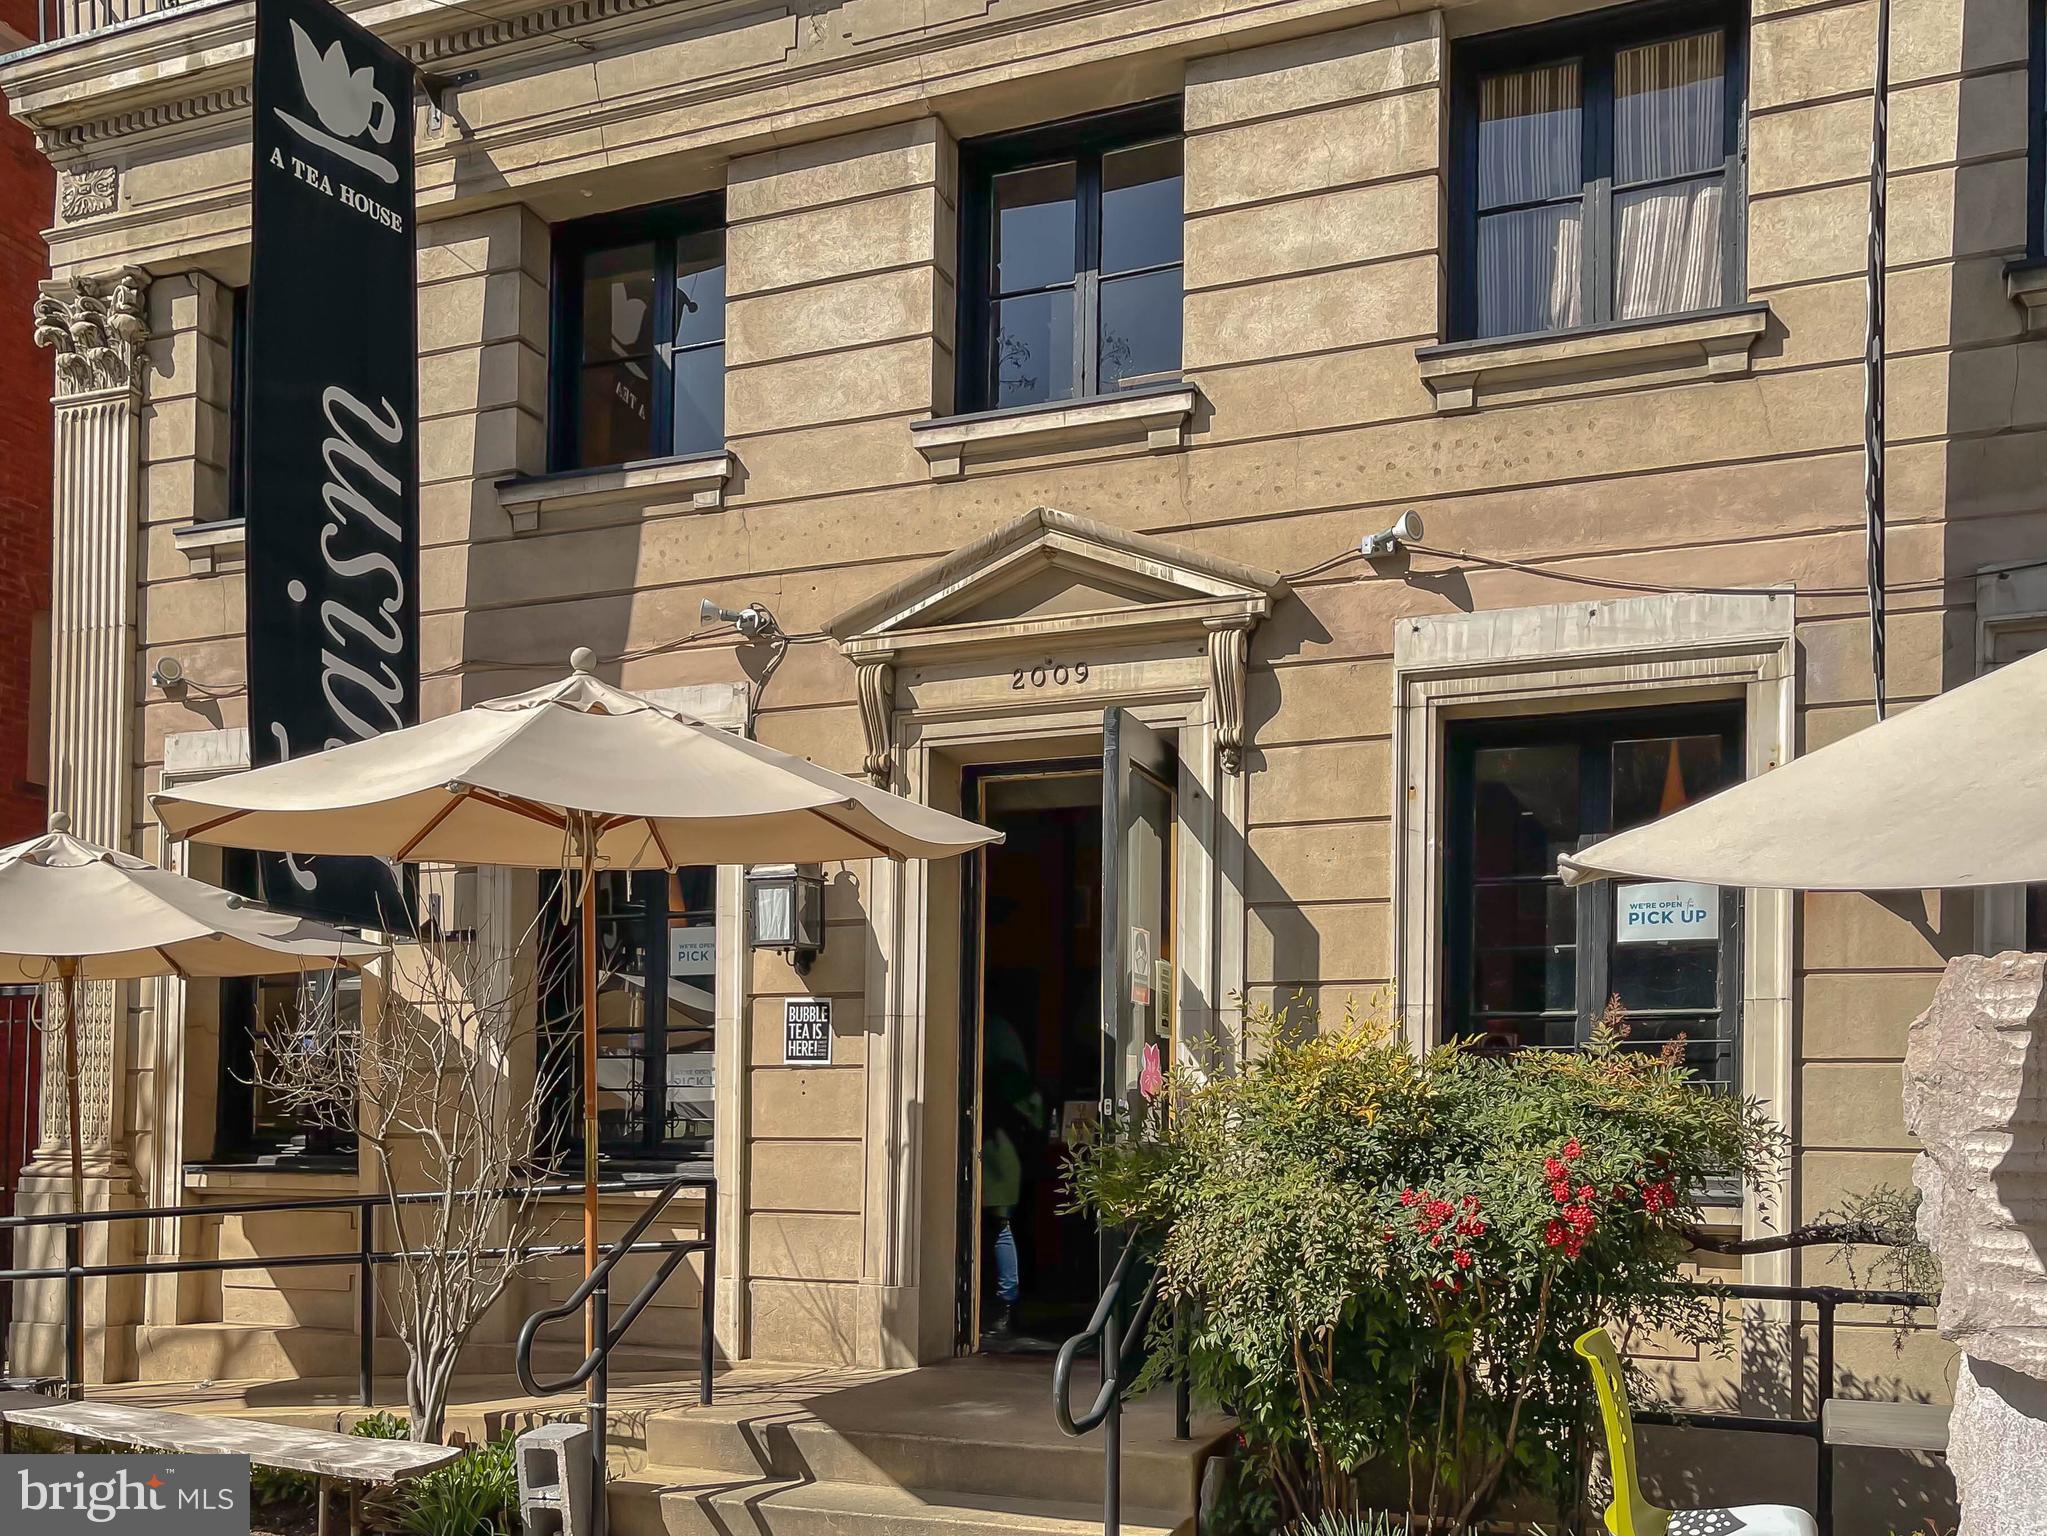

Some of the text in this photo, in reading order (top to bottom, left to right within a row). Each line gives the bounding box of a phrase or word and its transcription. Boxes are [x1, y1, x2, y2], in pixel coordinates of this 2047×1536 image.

[269, 147, 402, 233] A TEA HOUSE
[271, 386, 403, 890] aism
[1012, 662, 1089, 690] 2009
[1629, 902, 1657, 910] WE'RE
[1628, 910, 1707, 925] PICK UP
[678, 951, 709, 961] PICK
[788, 1006, 828, 1022] BUBBLE
[788, 1023, 823, 1039] TEA IS
[788, 1040, 818, 1056] HERE!
